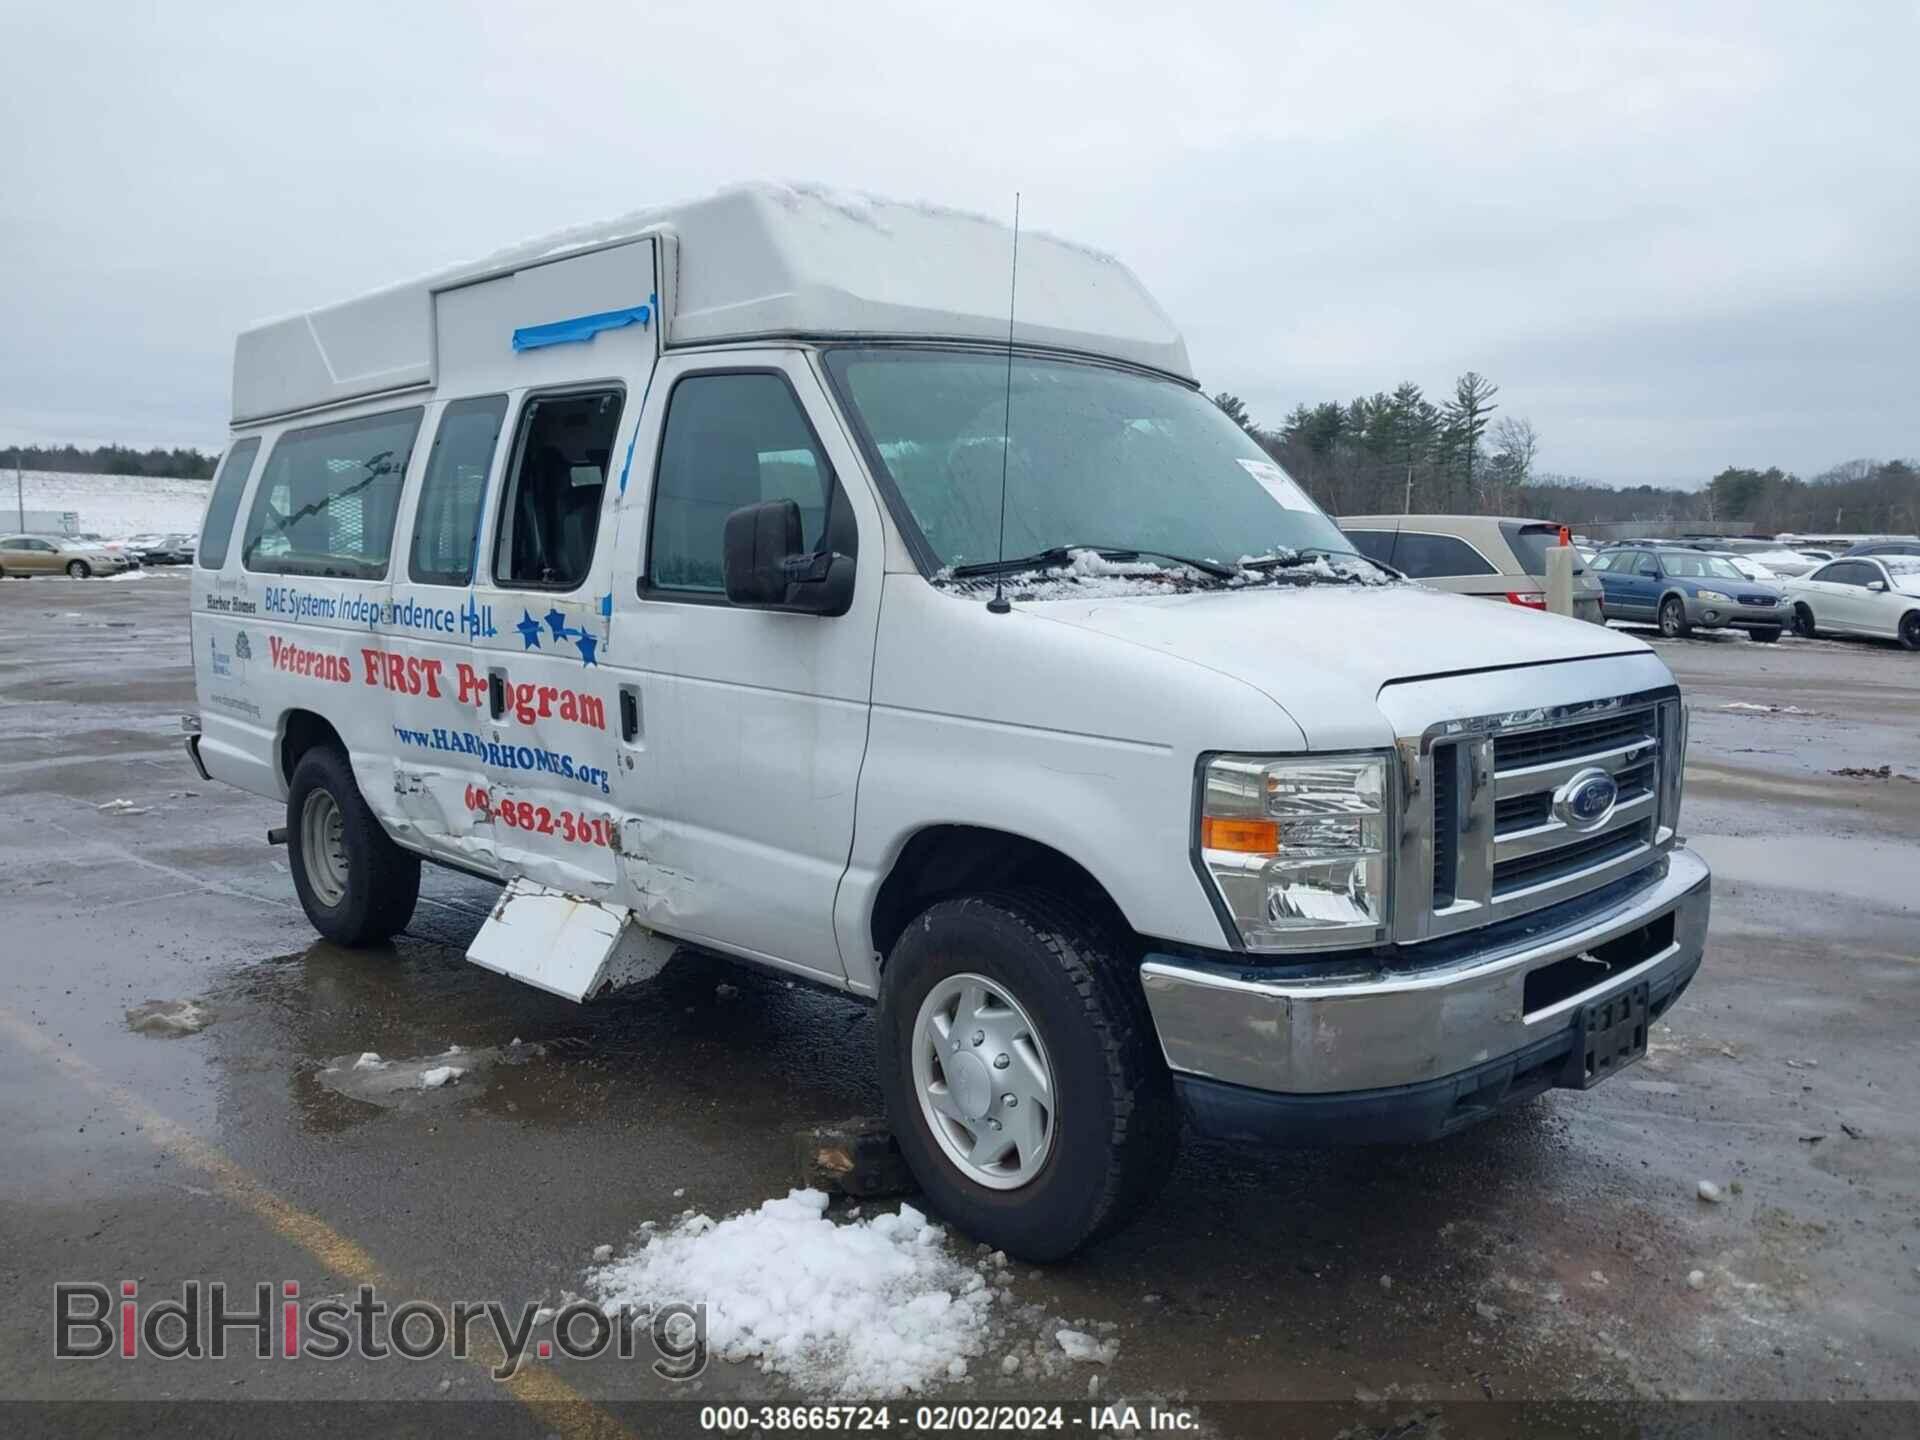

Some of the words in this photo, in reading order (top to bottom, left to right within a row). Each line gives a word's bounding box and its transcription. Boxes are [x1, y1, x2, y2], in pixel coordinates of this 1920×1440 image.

[265, 586, 287, 613] BAE
[288, 588, 337, 621] Systems
[460, 600, 494, 638] Hall
[269, 635, 352, 683] Veterans
[361, 648, 442, 699] FIRST
[393, 725, 610, 794] ww.HARRHOMES.org
[465, 784, 613, 847] 60-882-361
[1582, 785, 1611, 812] Ford
